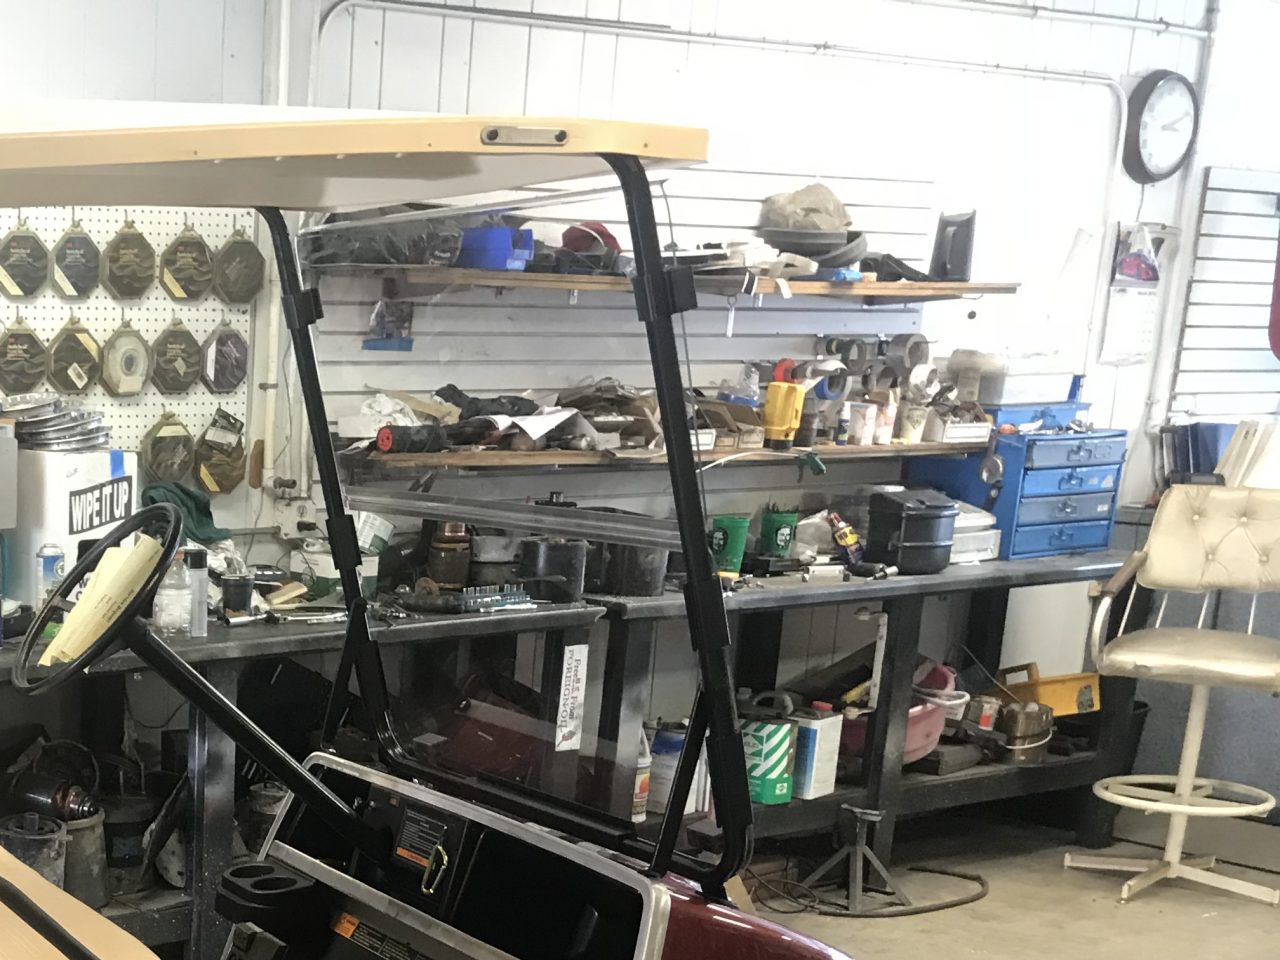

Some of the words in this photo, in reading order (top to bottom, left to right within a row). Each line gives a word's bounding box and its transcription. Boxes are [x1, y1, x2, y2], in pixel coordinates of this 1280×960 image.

[72, 489, 100, 532] WIPE
[102, 485, 112, 523] IT
[113, 481, 129, 519] UP
